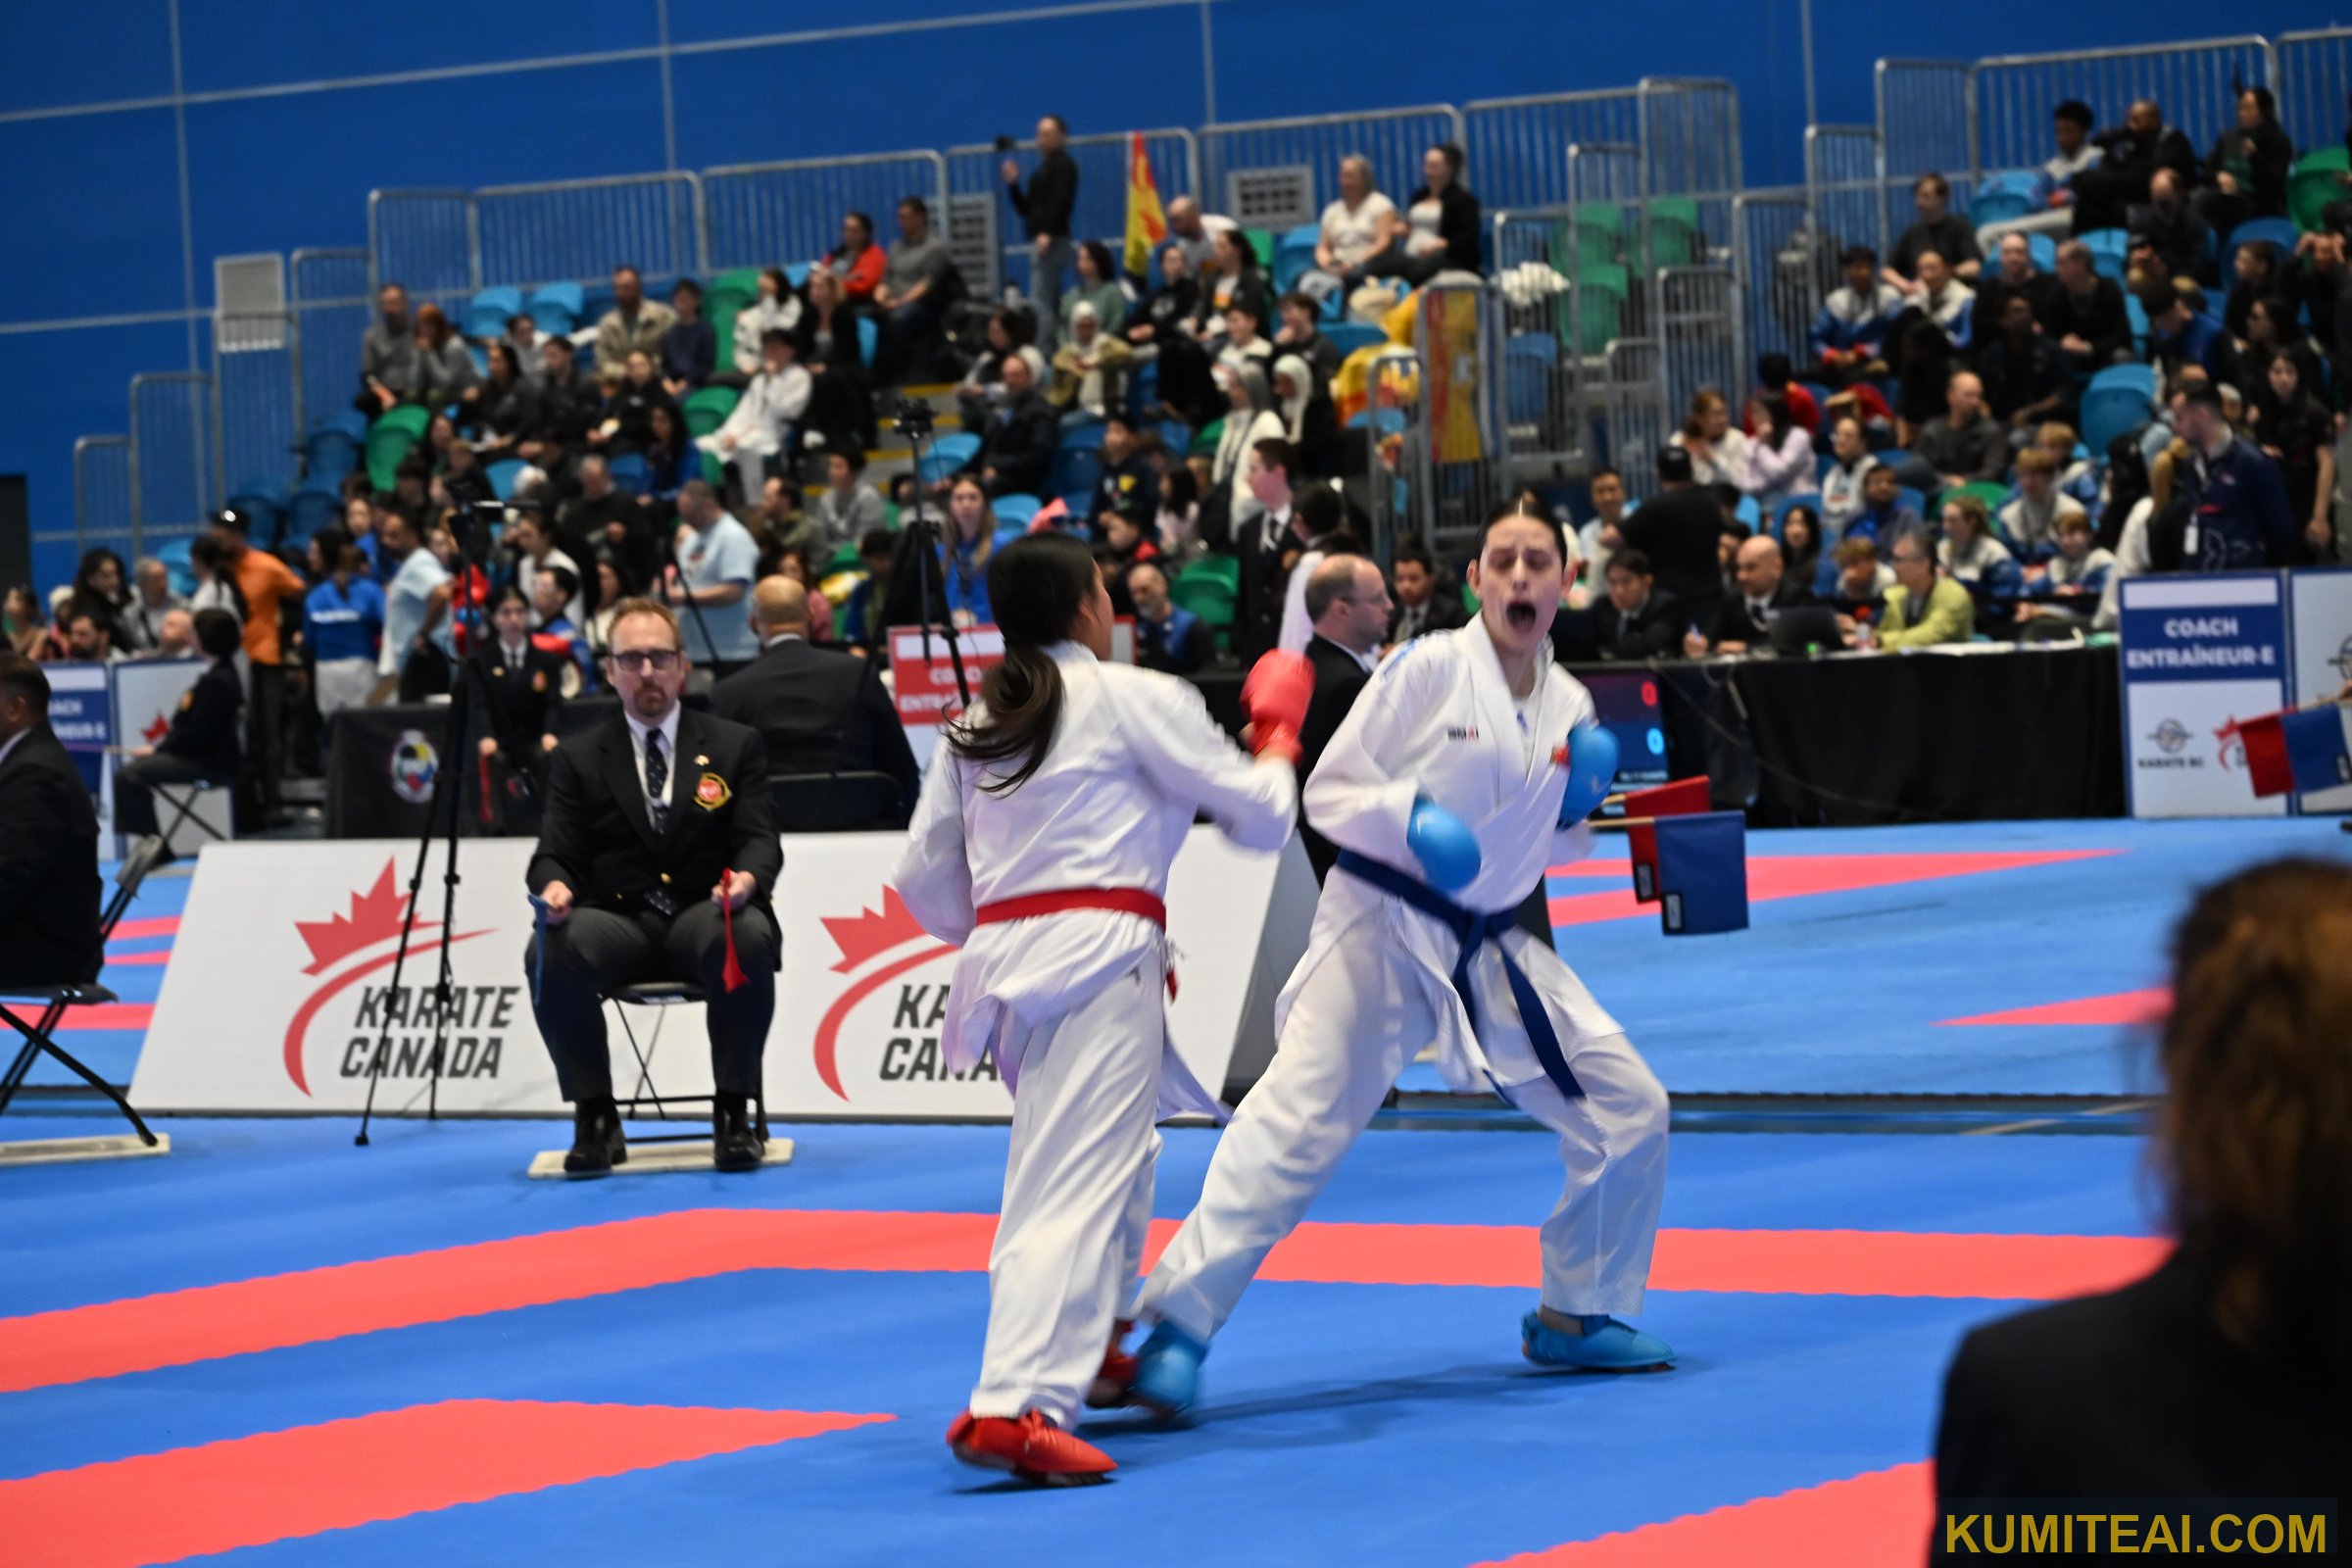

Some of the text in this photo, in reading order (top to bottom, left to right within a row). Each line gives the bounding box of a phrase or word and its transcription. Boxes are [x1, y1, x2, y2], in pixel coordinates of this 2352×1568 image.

[2164, 616, 2238, 638] COACH
[354, 986, 521, 1029] KARATE
[340, 1037, 503, 1078] CANADA
